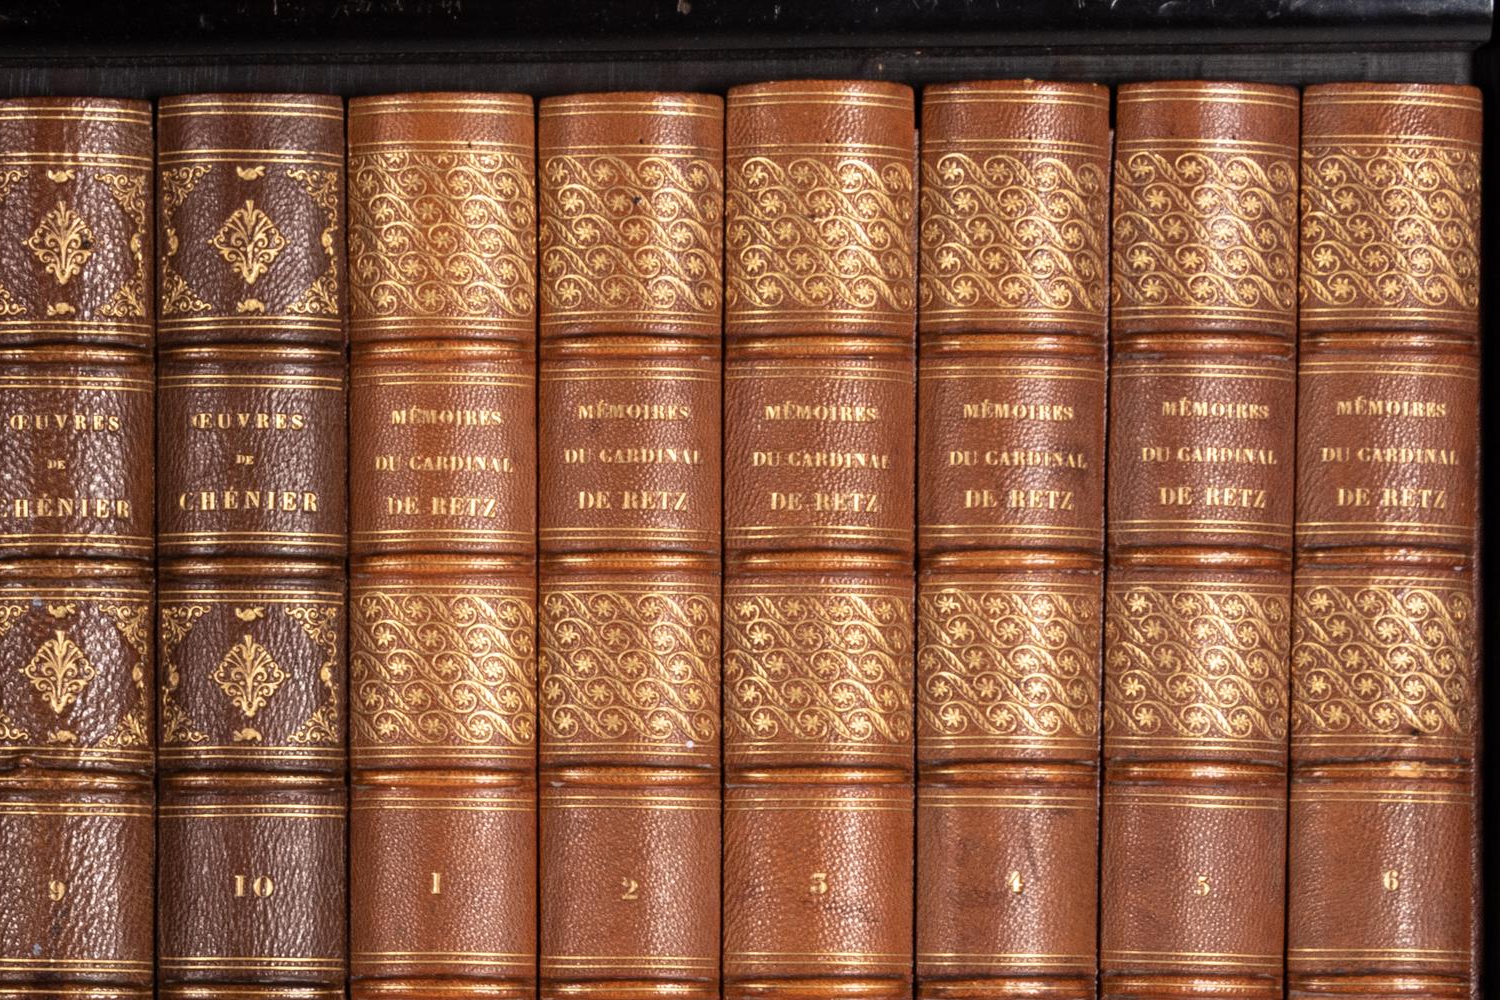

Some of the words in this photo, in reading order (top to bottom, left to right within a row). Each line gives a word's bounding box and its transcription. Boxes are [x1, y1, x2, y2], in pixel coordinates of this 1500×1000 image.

[392, 404, 502, 426] MÉMOIRES
[578, 400, 689, 421] MÉMOIRES
[765, 401, 877, 422] MÉMOIRES
[963, 401, 1073, 421] MÉMOIRES
[1162, 399, 1270, 420] MÉMOIRES
[1337, 398, 1446, 419] MÉMOIRES
[10, 414, 119, 432] ŒUVRES
[192, 412, 304, 431] ŒUVRES
[48, 459, 65, 470] DE
[236, 454, 254, 465] DE
[376, 456, 402, 471] DU
[409, 454, 512, 473] CARDINAL
[564, 449, 591, 463] DU
[599, 446, 701, 465] CARDINAL
[753, 451, 780, 466] DU
[788, 451, 890, 470] CARDINAL
[949, 450, 977, 466] DU
[983, 449, 1086, 468] CARDINAL
[1142, 447, 1170, 462] DU
[1177, 447, 1277, 466] CARDINAL
[1321, 447, 1350, 463] DU
[1357, 447, 1458, 467] CARDINAL
[180, 489, 318, 512] CHÉNIER
[388, 498, 420, 516] DE
[431, 496, 496, 519] RETZ
[579, 491, 611, 510] DE
[622, 490, 688, 512] RETZ
[771, 492, 801, 510] DE
[814, 492, 878, 512] RETZ
[965, 491, 996, 509] DE
[1008, 491, 1073, 511] RETZ
[1160, 487, 1189, 505] DE
[1204, 487, 1266, 509] RETZ
[1337, 488, 1368, 506] DE
[1383, 487, 1446, 509] RETZ
[49, 880, 65, 902] 9
[234, 875, 274, 898] 10
[431, 872, 441, 894] 1
[621, 878, 638, 900] 2
[810, 873, 827, 894] 3
[1007, 871, 1024, 893] 4
[1197, 876, 1210, 896] 5
[1383, 870, 1399, 891] 6
